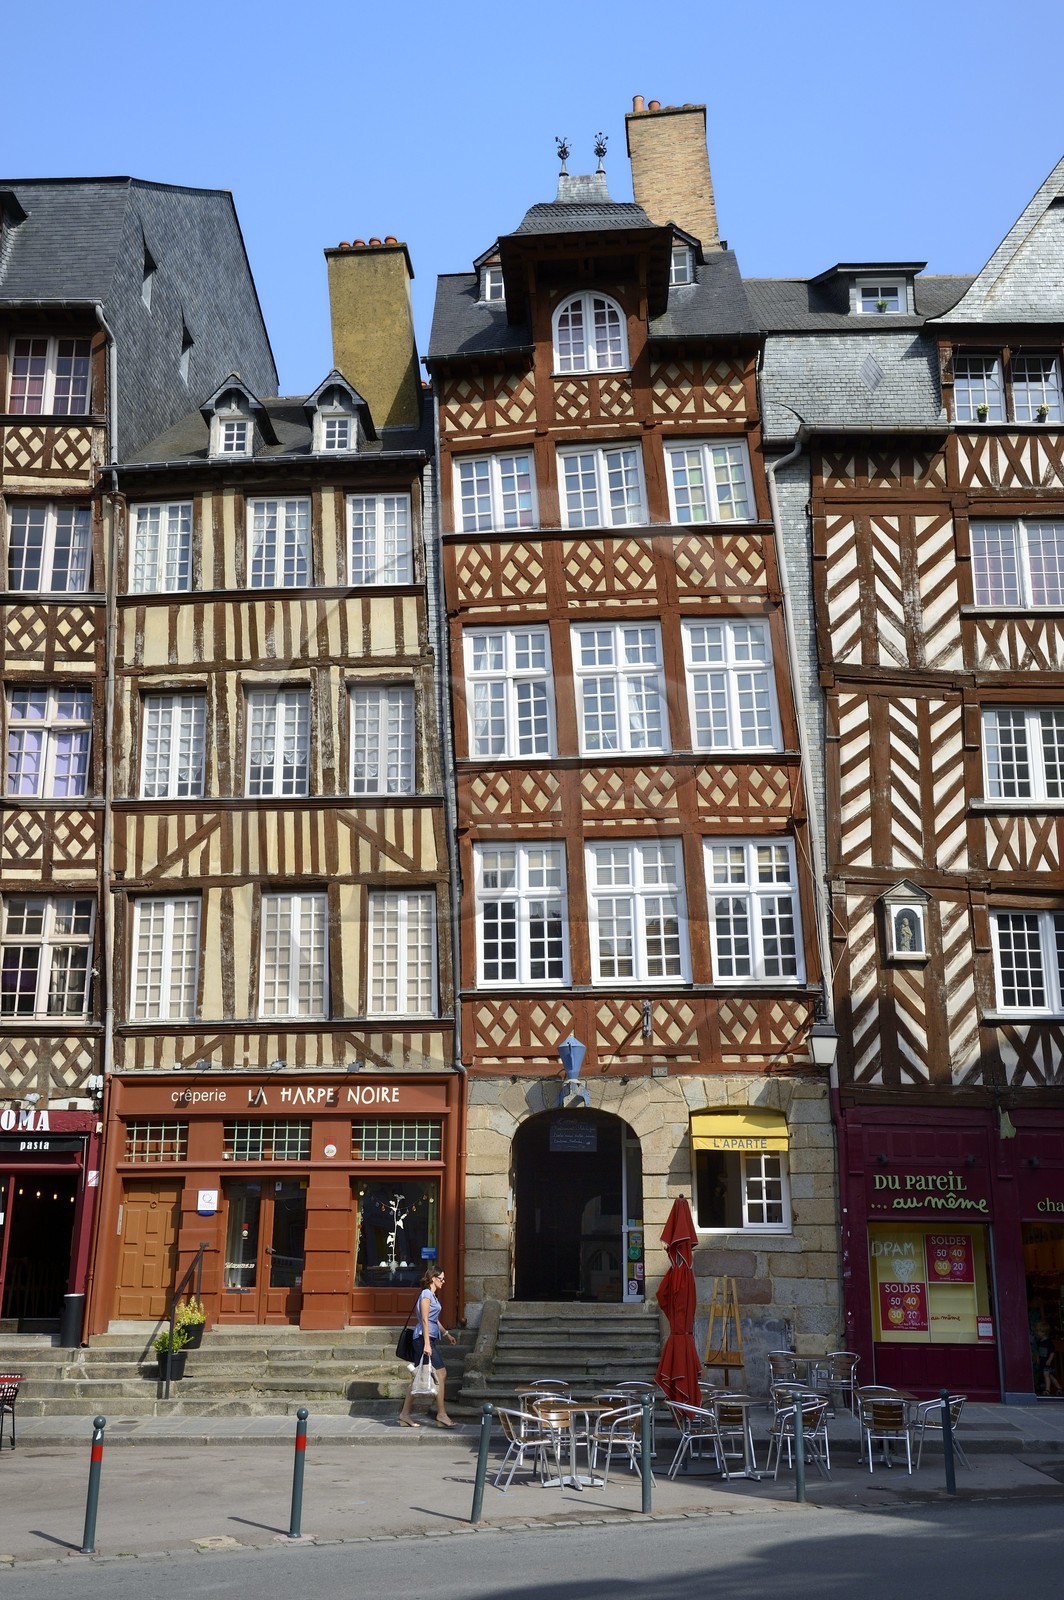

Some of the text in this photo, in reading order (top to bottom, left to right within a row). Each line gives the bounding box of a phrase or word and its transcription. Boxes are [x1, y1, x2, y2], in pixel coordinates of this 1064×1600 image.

[171, 1085, 400, 1105] crêperie LA HARPE NOIRE
[0, 1109, 50, 1131] OMA
[20, 1141, 50, 1151] pasta
[892, 1196, 923, 1209] au
[924, 1192, 989, 1213] même
[1037, 1197, 1064, 1212] cha
[871, 1240, 915, 1257] DPAM
[931, 1236, 967, 1246] SOLDES
[885, 1284, 921, 1293] SOLDES
